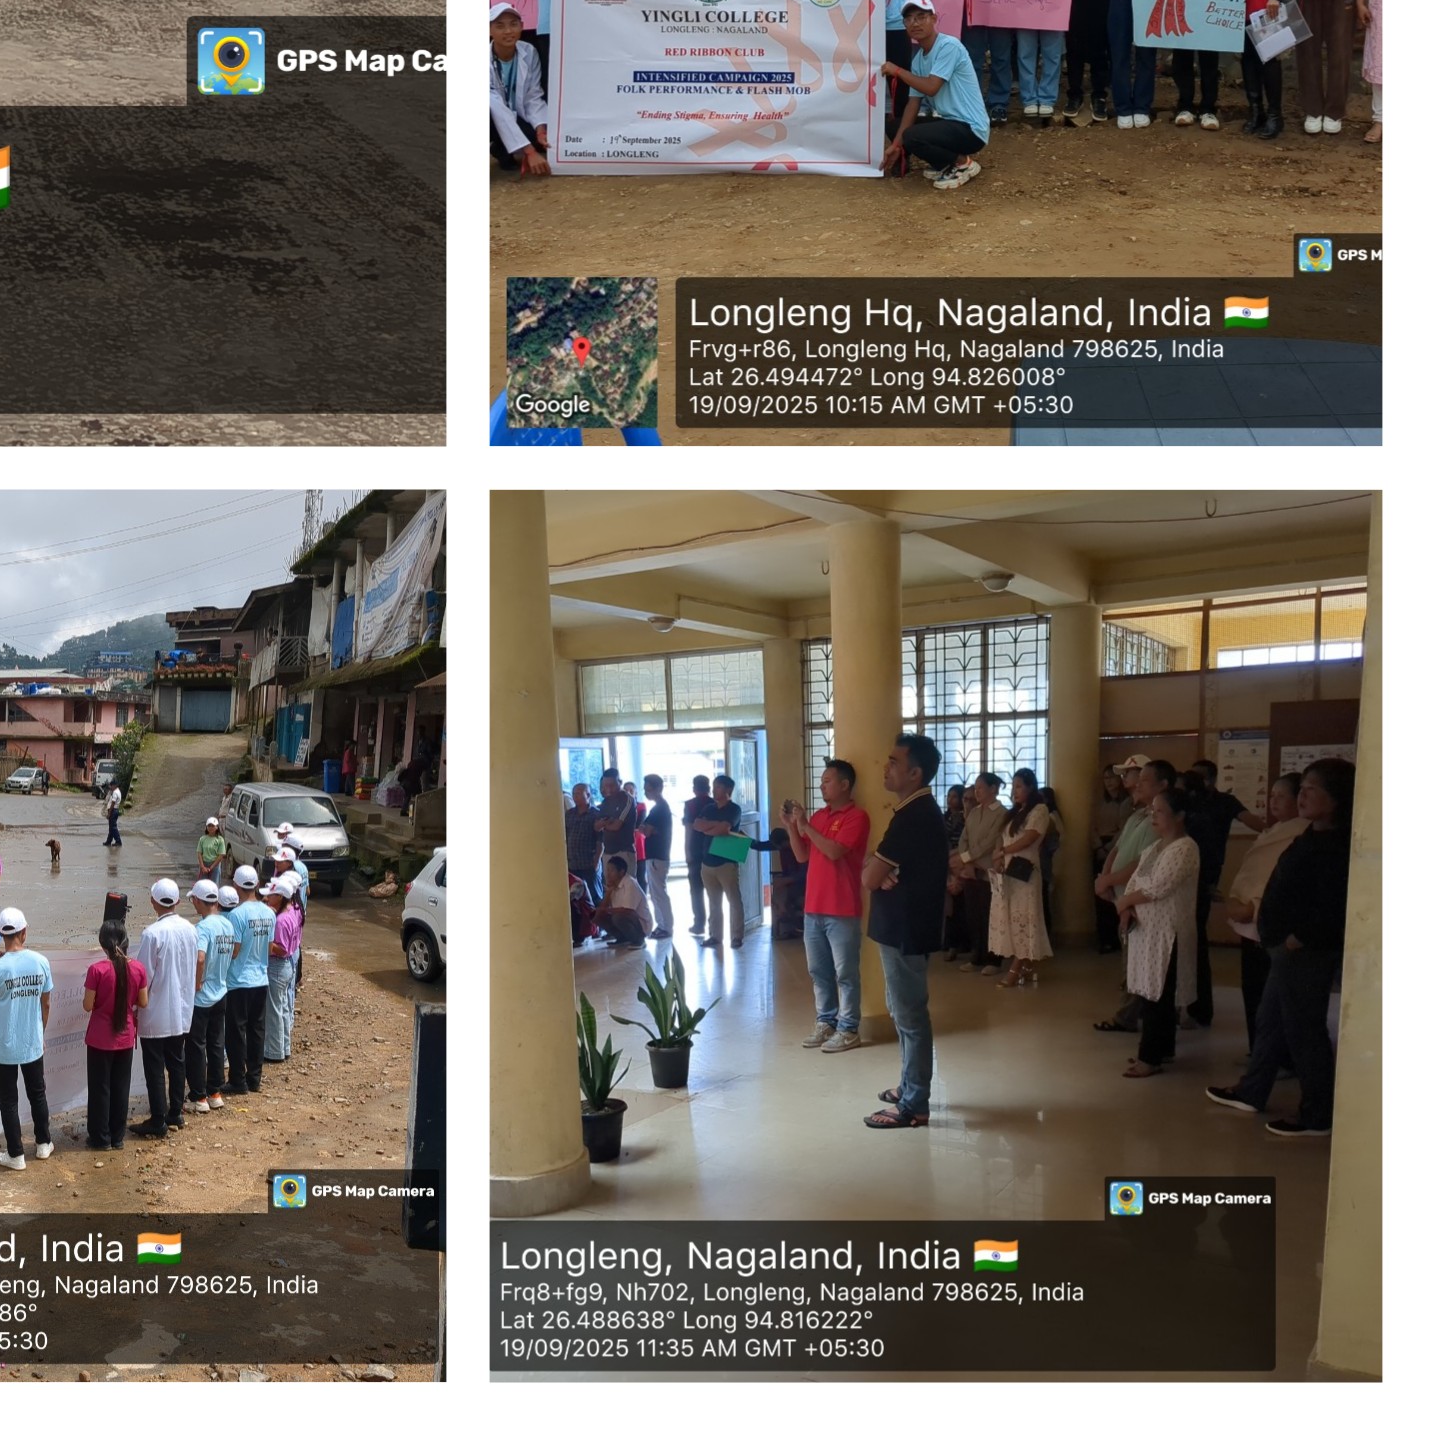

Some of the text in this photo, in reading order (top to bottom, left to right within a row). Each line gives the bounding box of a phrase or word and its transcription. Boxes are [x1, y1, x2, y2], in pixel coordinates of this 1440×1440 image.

[1206, 0, 1245, 19] BETTER
[641, 9, 790, 24] YINGLI COLLEGE
[1205, 14, 1244, 31] CHOICE
[664, 47, 765, 58] RED RIBBON CLUB
[635, 72, 793, 83] INTENSIFIED CAMPAIGN 2025
[616, 85, 811, 96] FOLK PERFORMANCE & FLASH MOB
[10, 988, 39, 1000] LONGLENG
